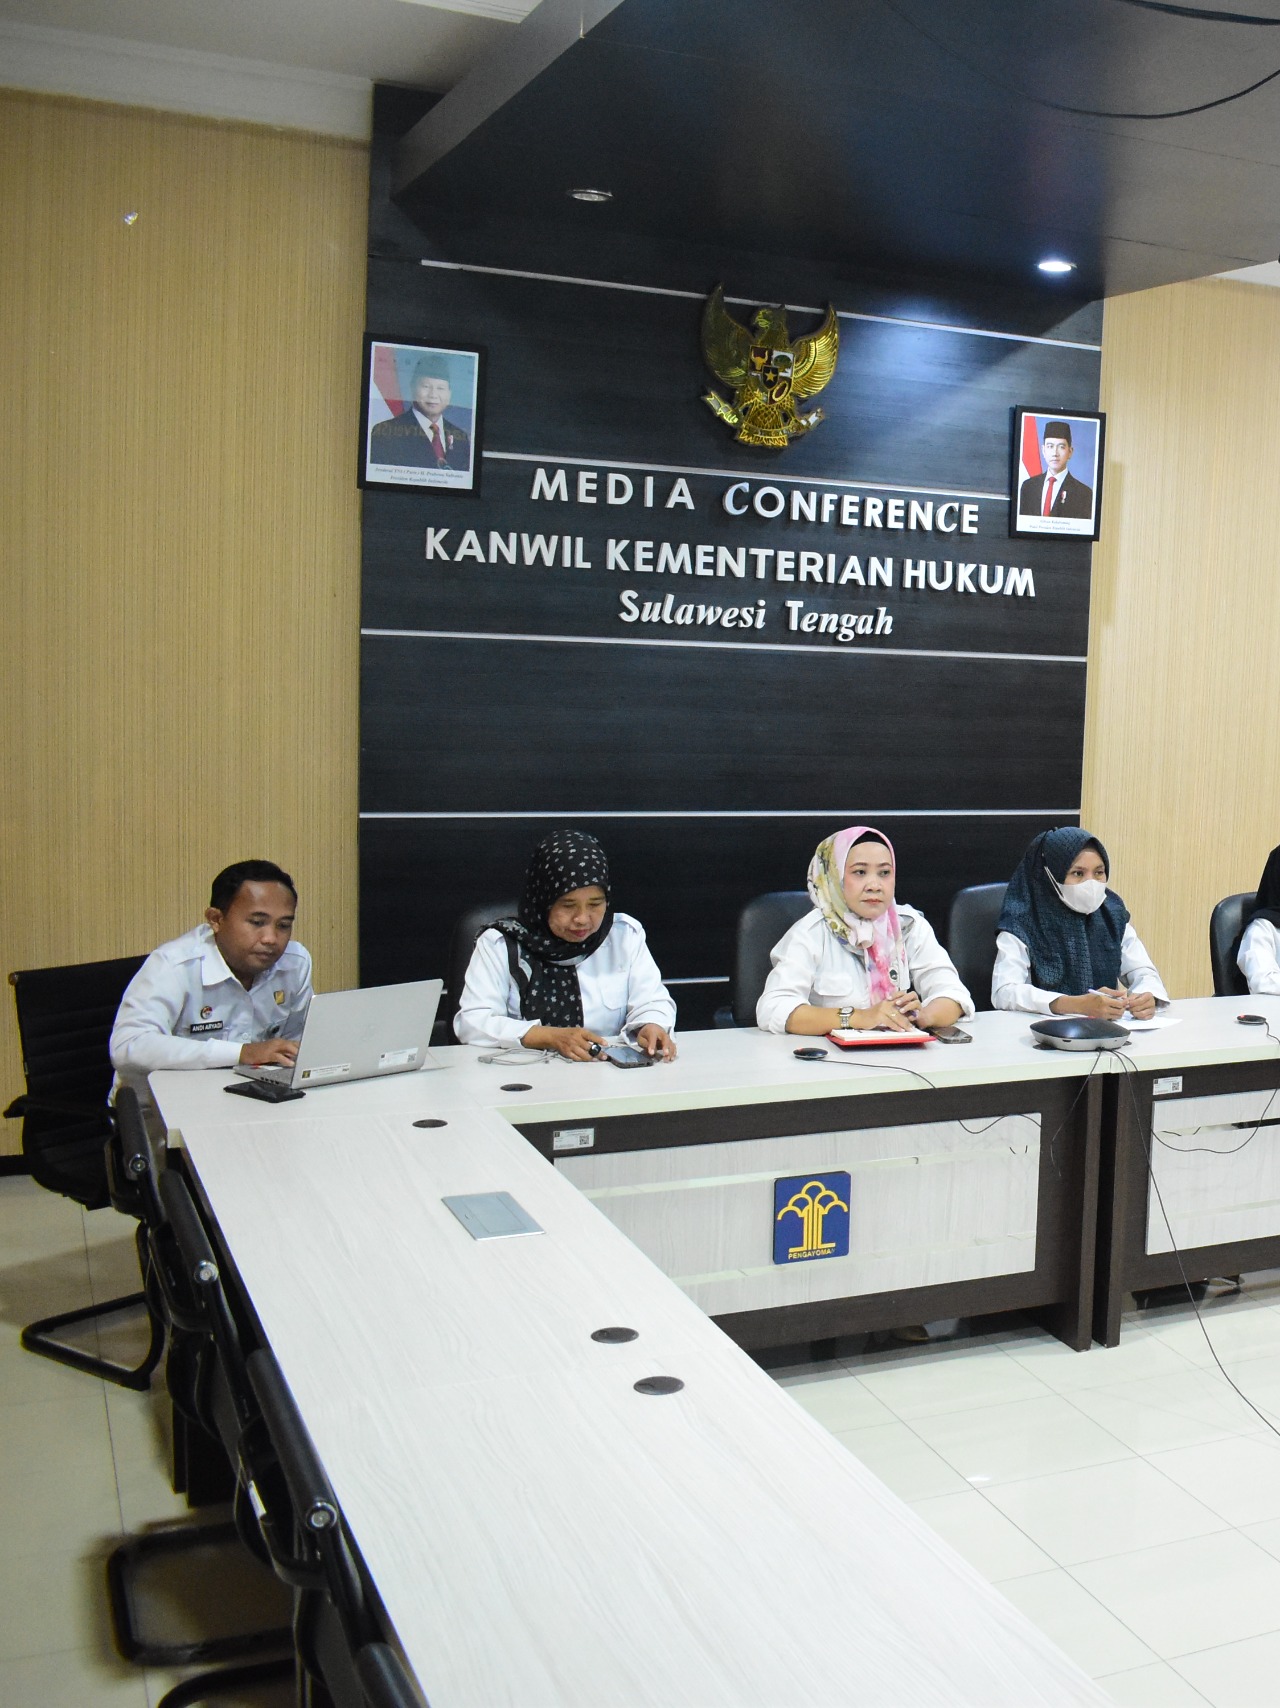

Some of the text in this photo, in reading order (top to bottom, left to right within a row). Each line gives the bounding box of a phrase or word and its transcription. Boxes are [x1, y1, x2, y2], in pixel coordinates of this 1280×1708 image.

[530, 468, 979, 534] MEDIA CONFERENCE
[425, 526, 1036, 597] KANWIL KEMENTERIAN HUKUM
[618, 589, 893, 642] Sulawesi Tengah
[192, 1023, 204, 1032] ANDI
